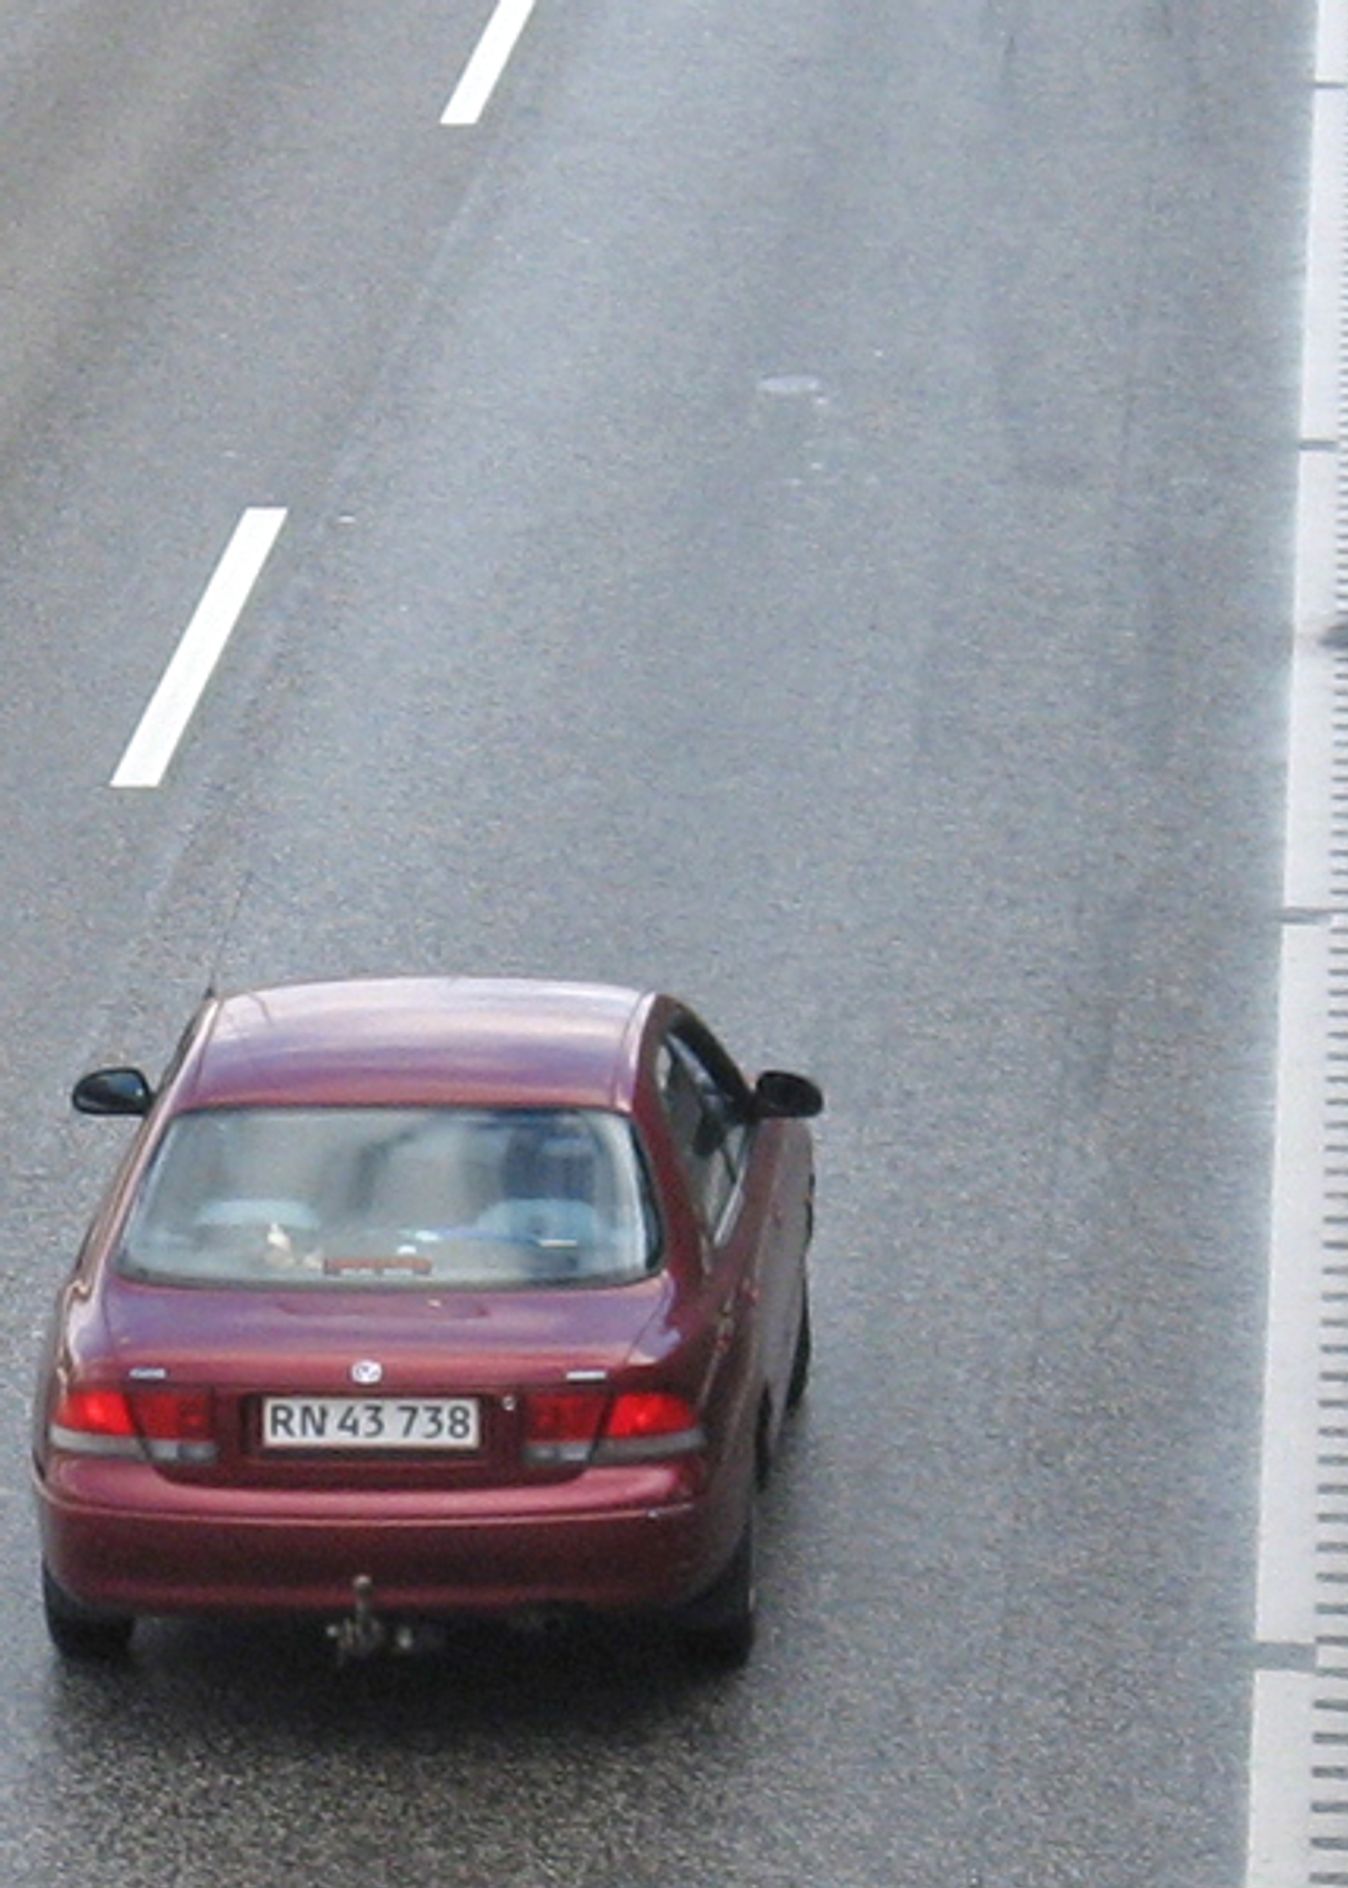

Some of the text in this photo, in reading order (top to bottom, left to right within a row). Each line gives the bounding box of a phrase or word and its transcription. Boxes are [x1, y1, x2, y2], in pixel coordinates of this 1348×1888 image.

[270, 1405, 471, 1439] RN 43 738
